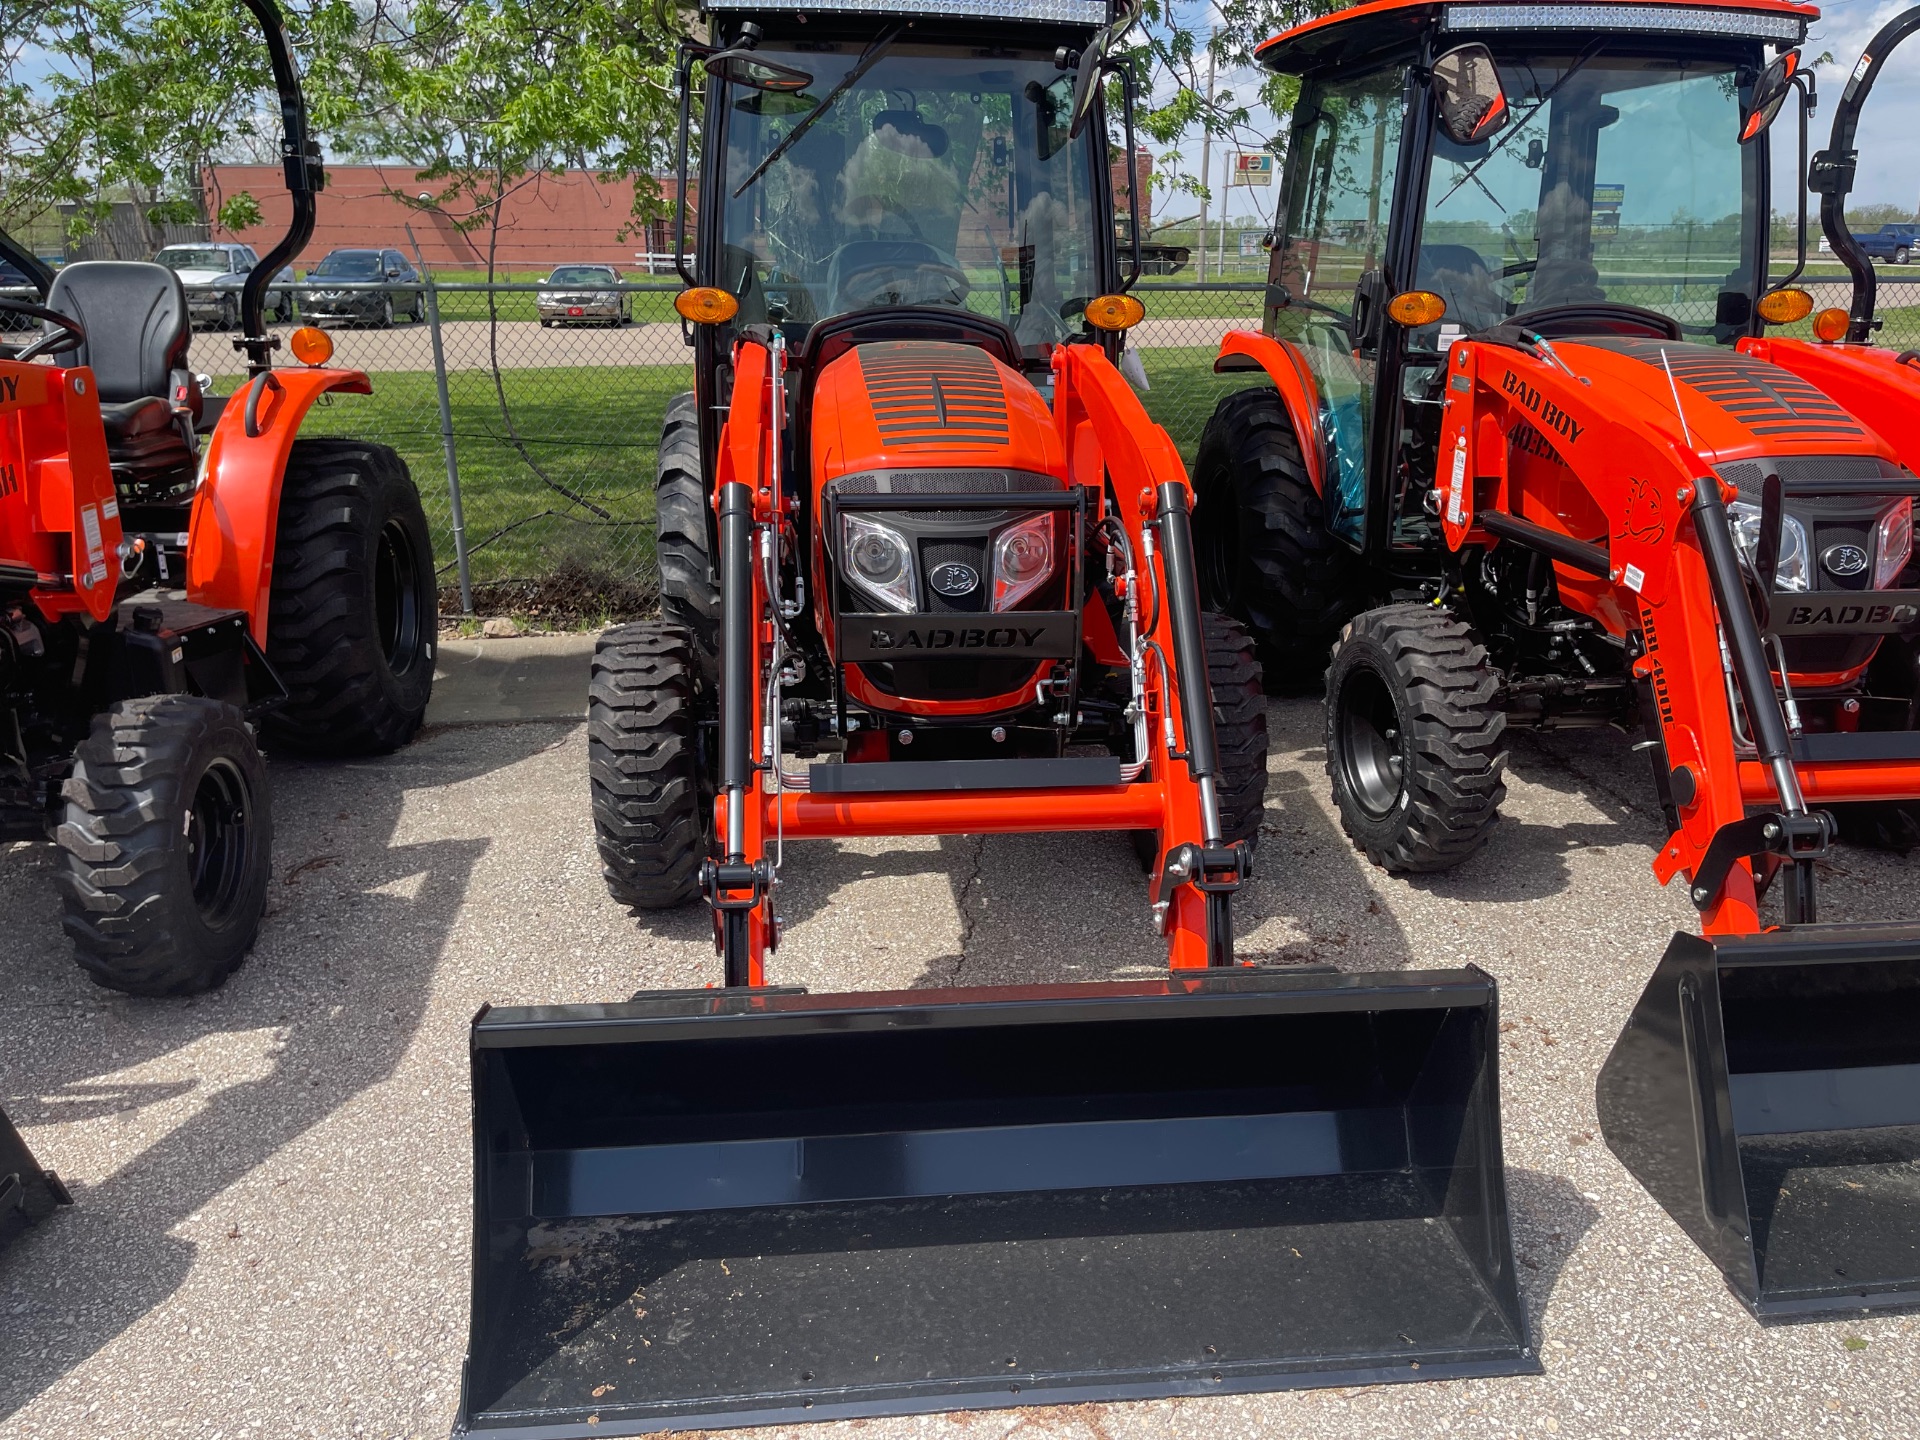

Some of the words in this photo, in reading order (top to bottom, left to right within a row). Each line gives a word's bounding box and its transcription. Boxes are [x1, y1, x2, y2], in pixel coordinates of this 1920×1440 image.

[1502, 369, 1541, 413] BAD
[1541, 399, 1585, 444] BOY
[1786, 603, 1919, 625] BADBO
